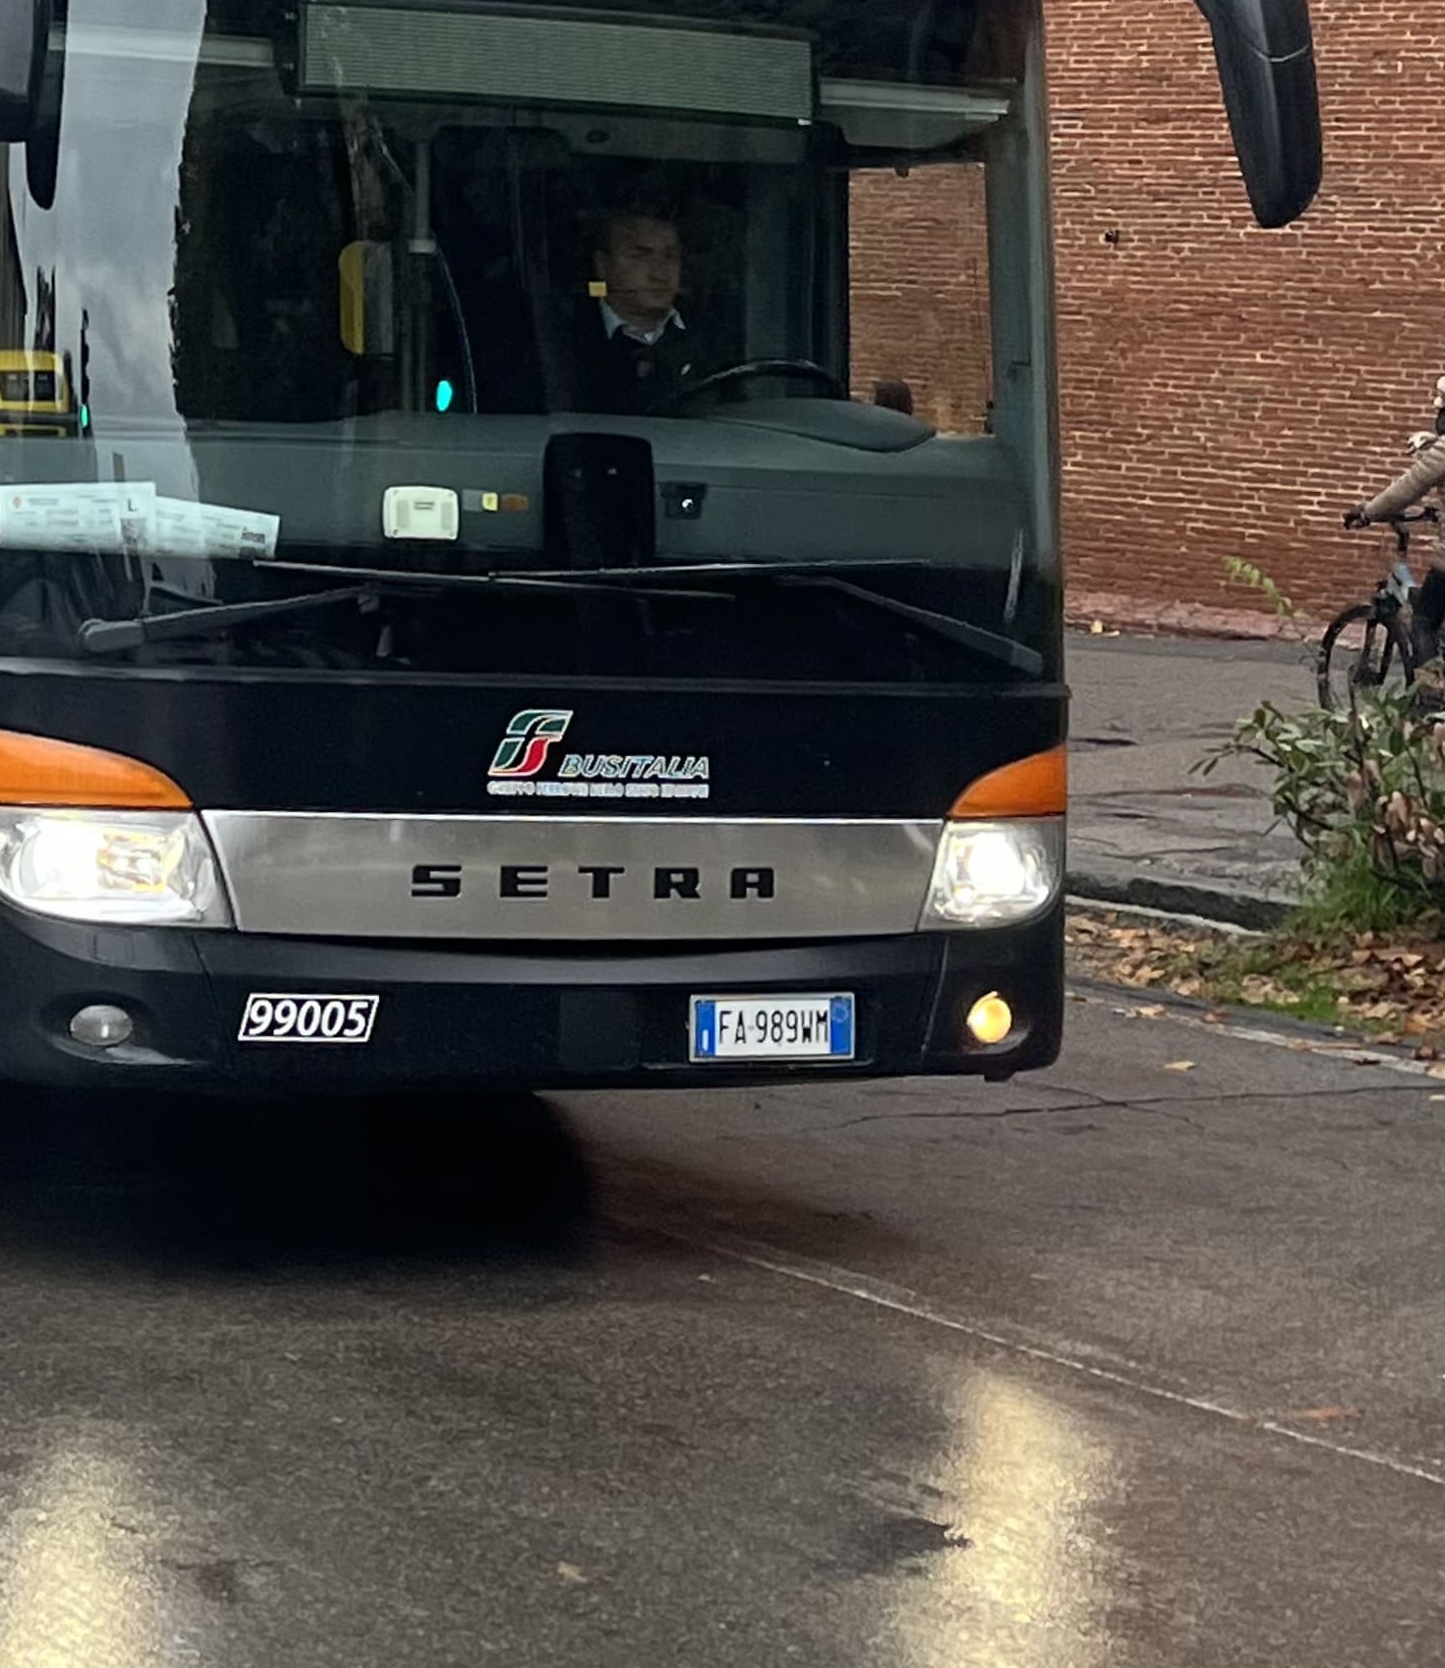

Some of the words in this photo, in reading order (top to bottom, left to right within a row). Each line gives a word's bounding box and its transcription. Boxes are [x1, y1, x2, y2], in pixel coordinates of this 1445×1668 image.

[557, 754, 710, 780] BUSITALIA
[411, 864, 775, 899] SETRA
[248, 999, 369, 1037] 99005
